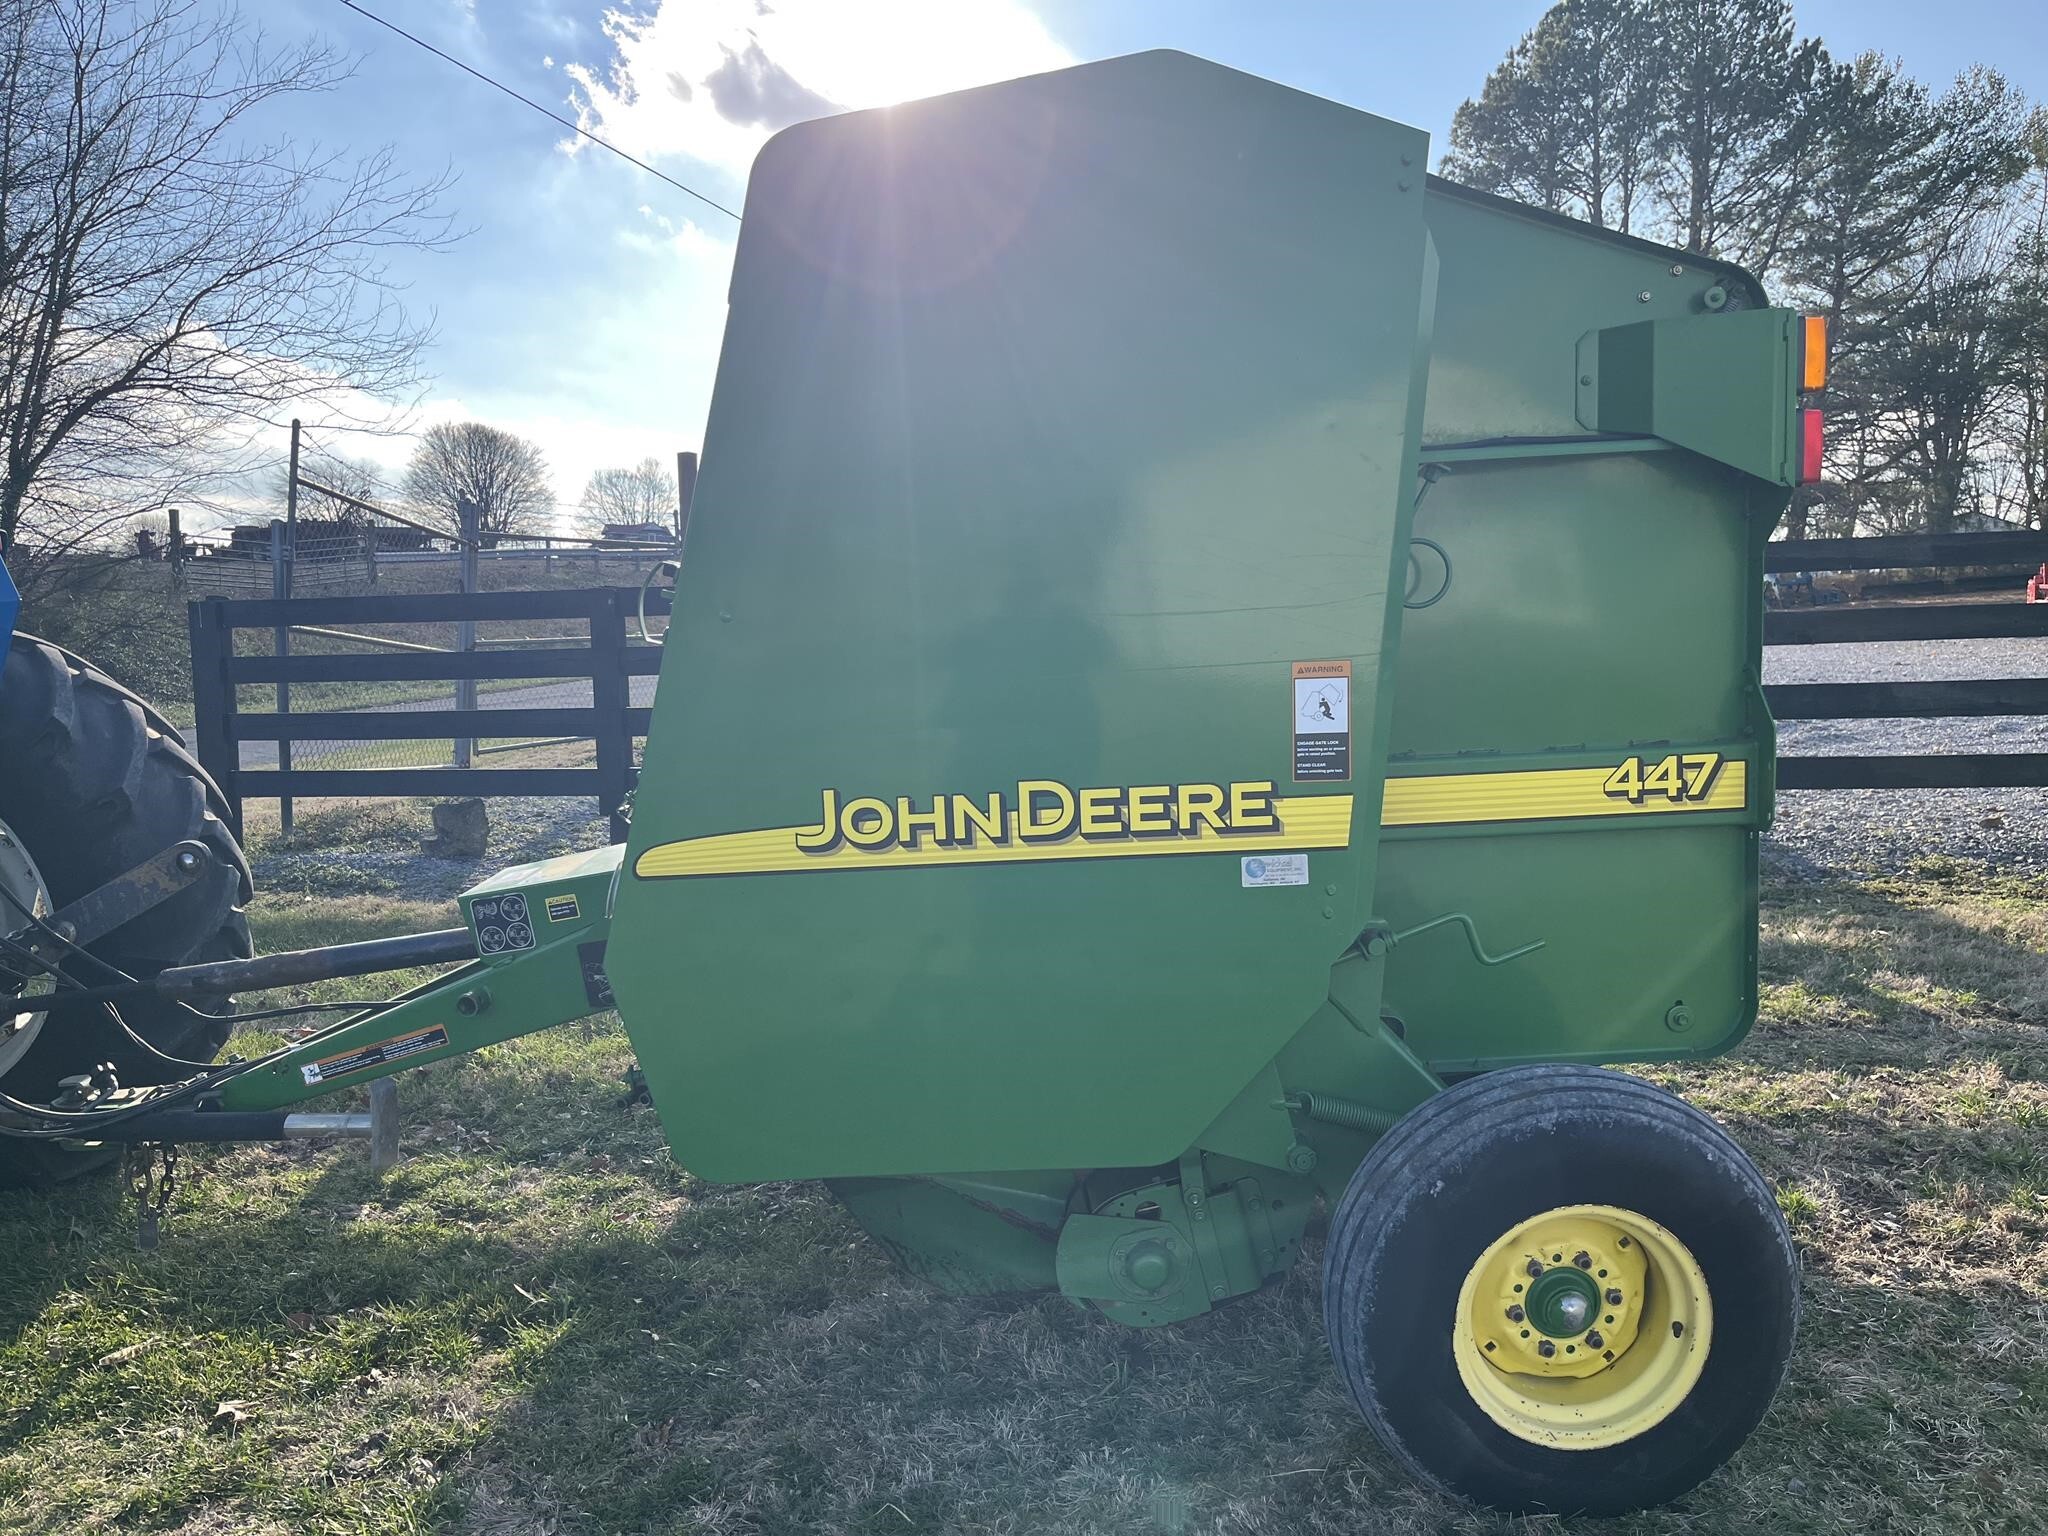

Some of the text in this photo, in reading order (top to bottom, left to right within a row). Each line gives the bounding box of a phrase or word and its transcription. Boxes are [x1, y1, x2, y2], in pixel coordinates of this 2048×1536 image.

[1304, 665, 1344, 673] WARNING
[1603, 752, 1723, 804] 447
[796, 779, 1277, 853] JOHN DEERE
